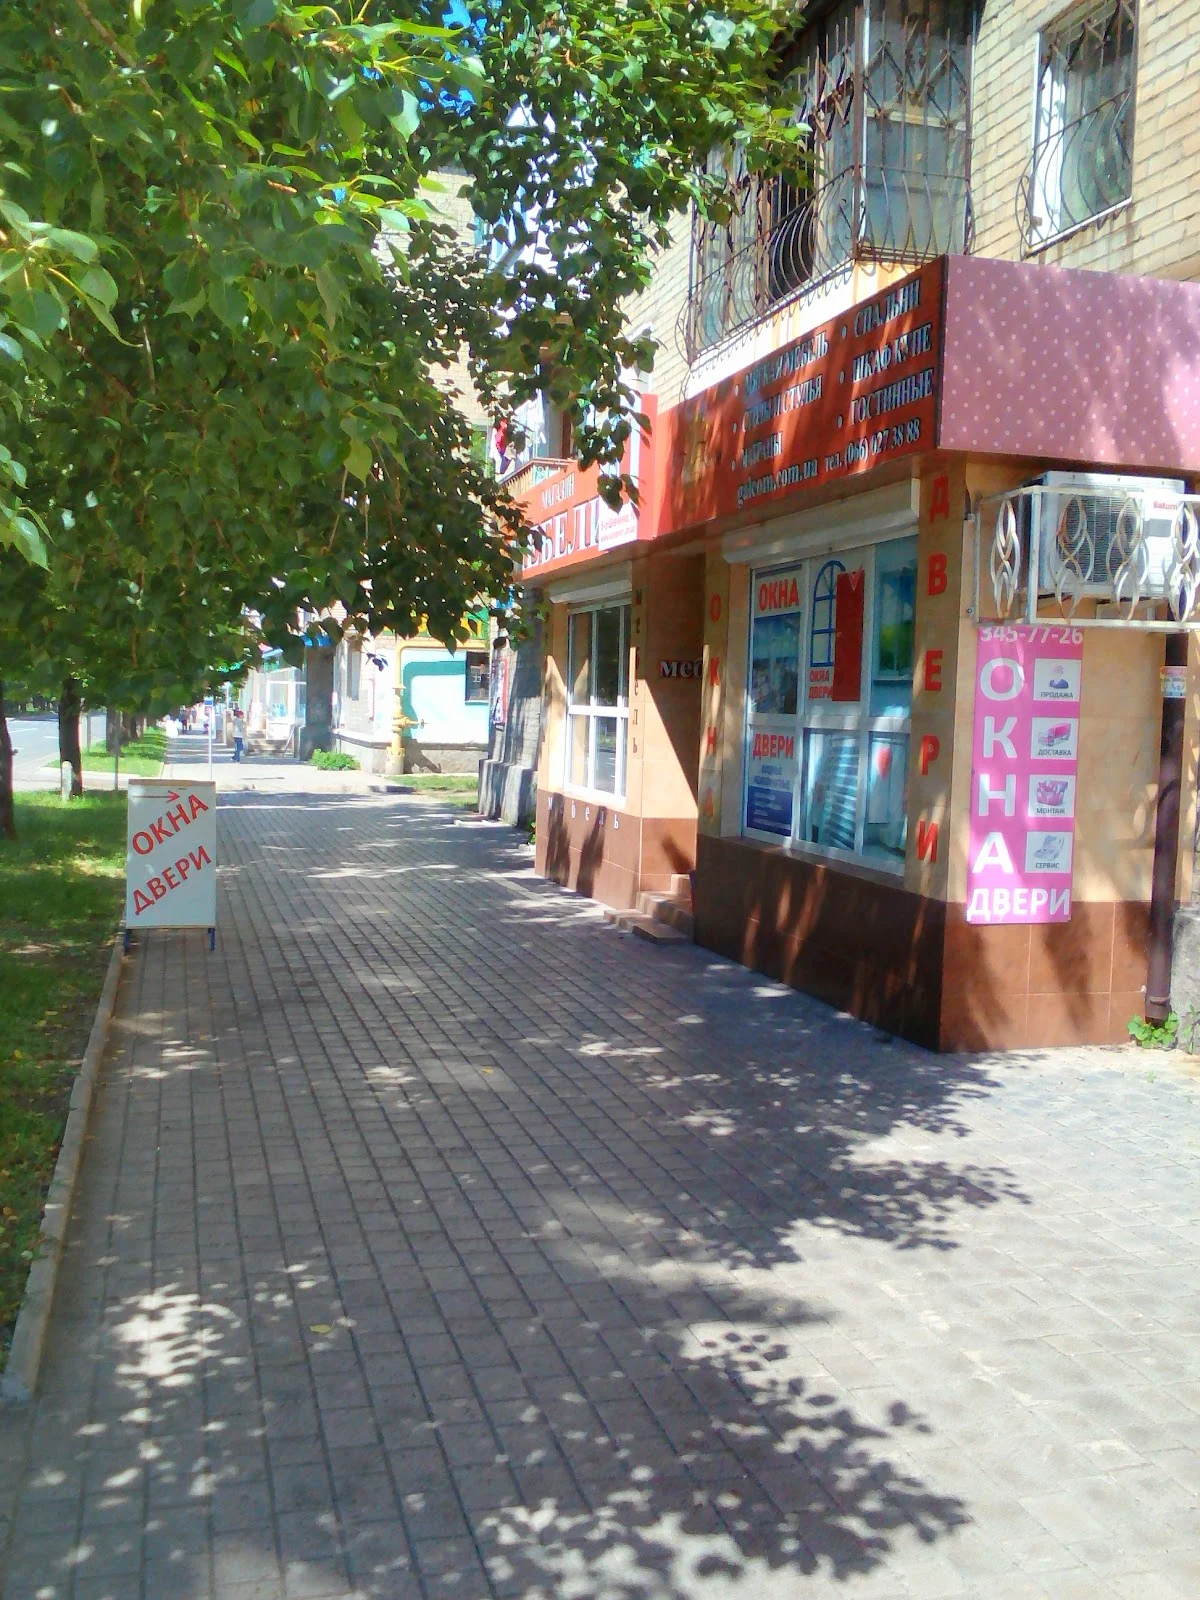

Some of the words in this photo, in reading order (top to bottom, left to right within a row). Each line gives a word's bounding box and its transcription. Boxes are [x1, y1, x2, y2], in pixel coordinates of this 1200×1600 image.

[854, 279, 920, 338] СПАЛЬНИ
[852, 344, 892, 382] ШКАФ
[782, 374, 822, 412] СТУЛЬЯ
[851, 368, 933, 426] ГОСТИННЫЕ
[907, 418, 920, 443] 88
[1153, 500, 1178, 511] Saturn
[757, 577, 800, 612] ОКНА
[980, 626, 1083, 645] 345-77-26
[1040, 691, 1074, 699] ПРОДАЖА
[753, 732, 795, 760] ДВЕРИ
[1037, 749, 1072, 757] ДОСТАВКА
[971, 657, 1025, 875] ОКНА
[132, 793, 209, 856] ОКНА
[1036, 807, 1066, 815] МОНТАЖ
[133, 845, 211, 916] ДВЕРИ
[1035, 862, 1060, 870] СЕРВИС
[967, 887, 1070, 923] ДВЕРИ
